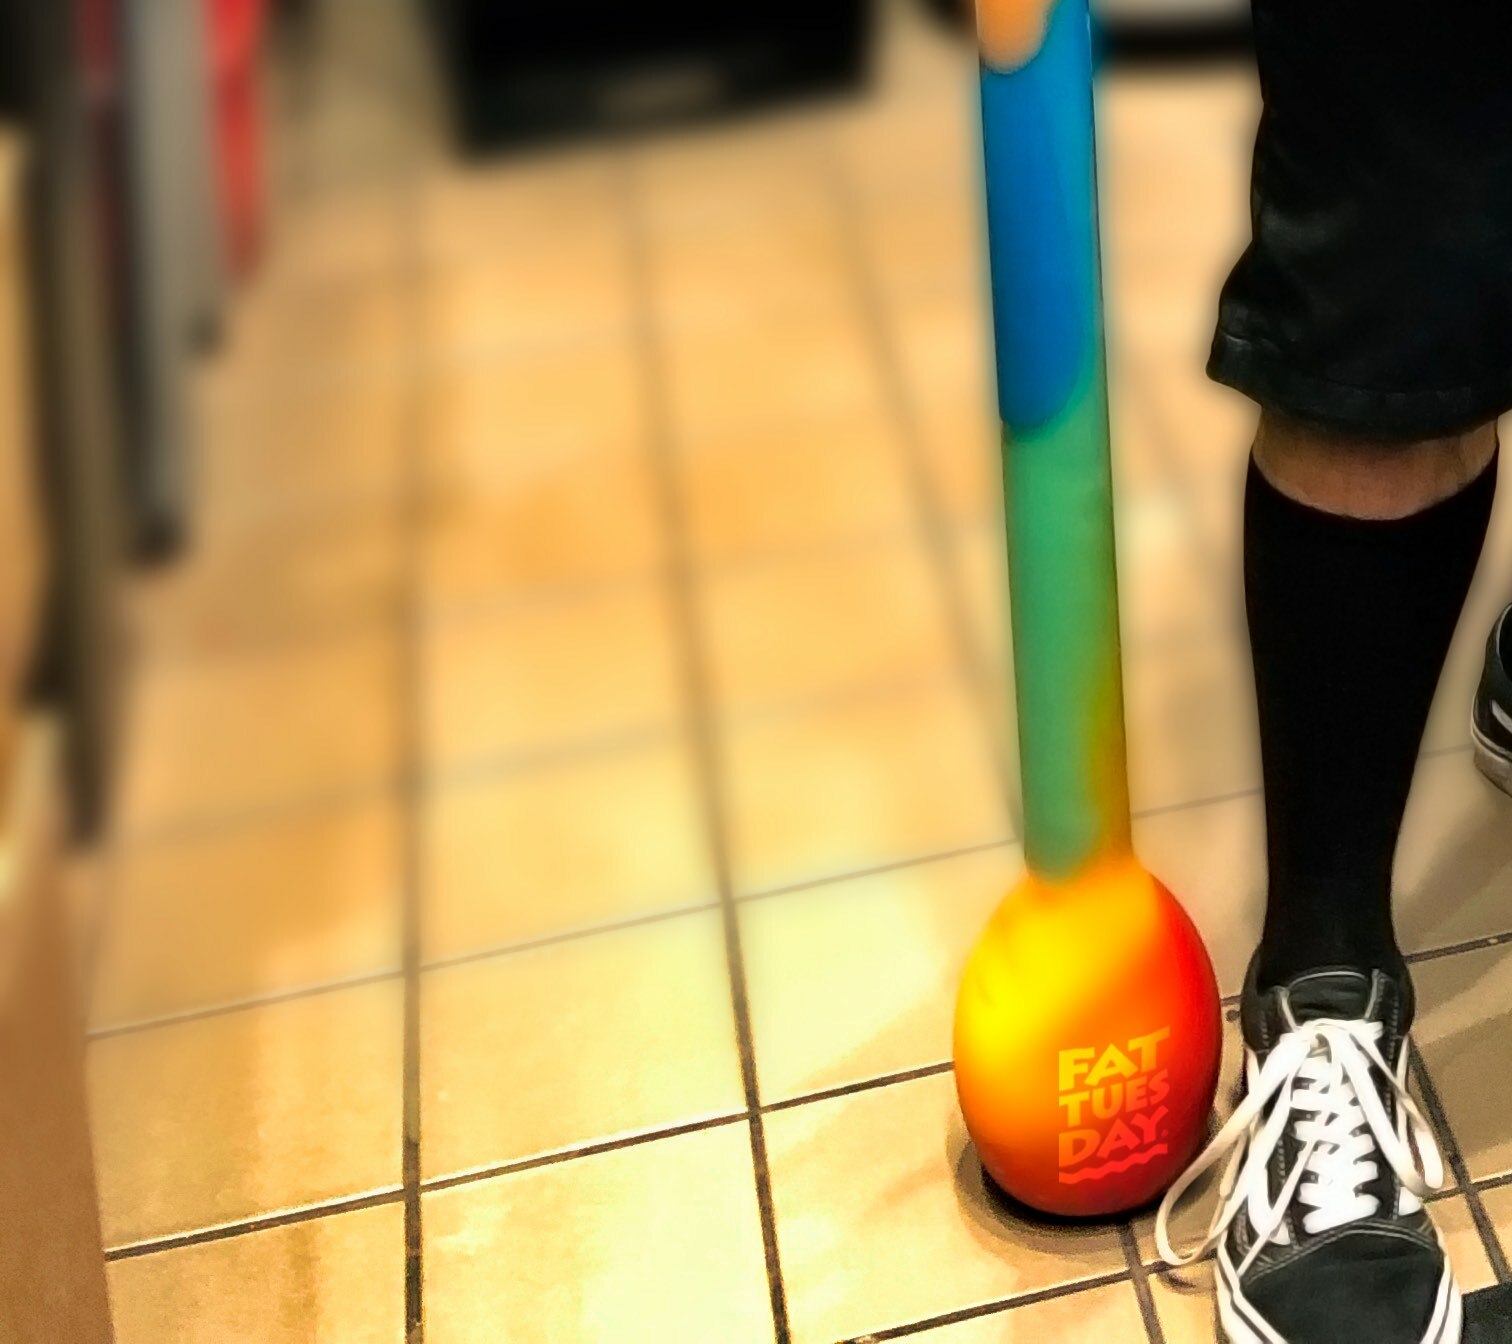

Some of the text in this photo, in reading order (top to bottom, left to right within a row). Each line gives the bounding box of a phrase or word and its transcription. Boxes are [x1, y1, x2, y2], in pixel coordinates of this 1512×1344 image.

[1058, 1026, 1170, 1091] FAT
[1058, 1068, 1169, 1127] TUES
[1058, 1105, 1169, 1167] DAY
